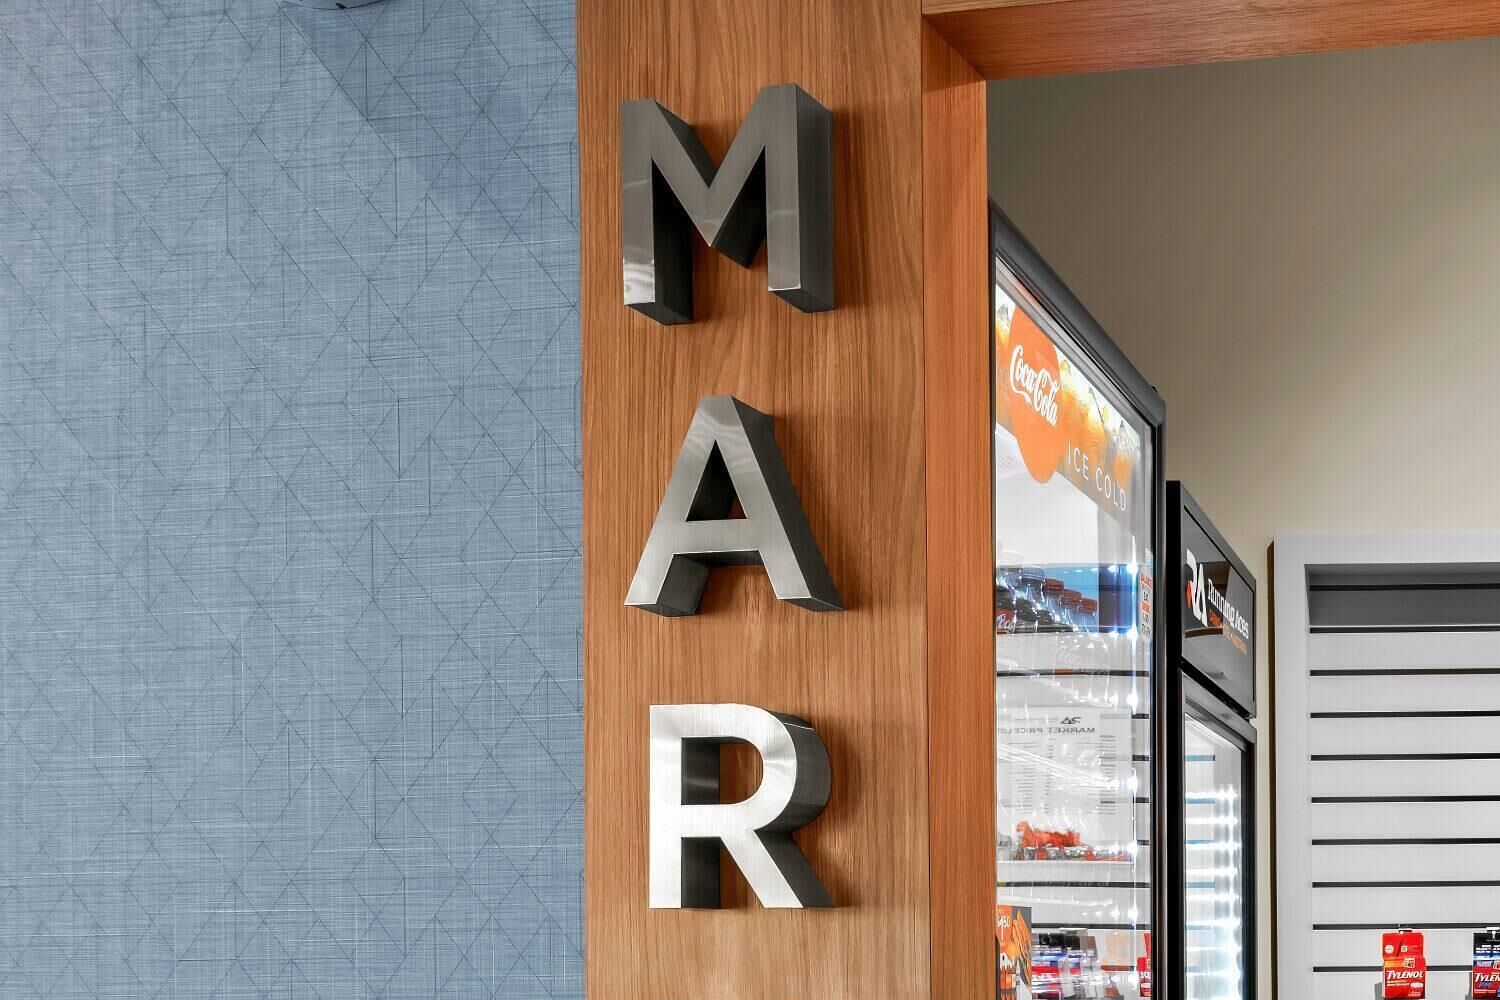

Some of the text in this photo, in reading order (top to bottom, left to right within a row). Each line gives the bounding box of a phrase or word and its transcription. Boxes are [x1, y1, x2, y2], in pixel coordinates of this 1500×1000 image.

[1010, 344, 1060, 426] Coca-Cola
[1067, 441, 1127, 512] ICE COLD
[1386, 970, 1424, 981] TYLENOL
